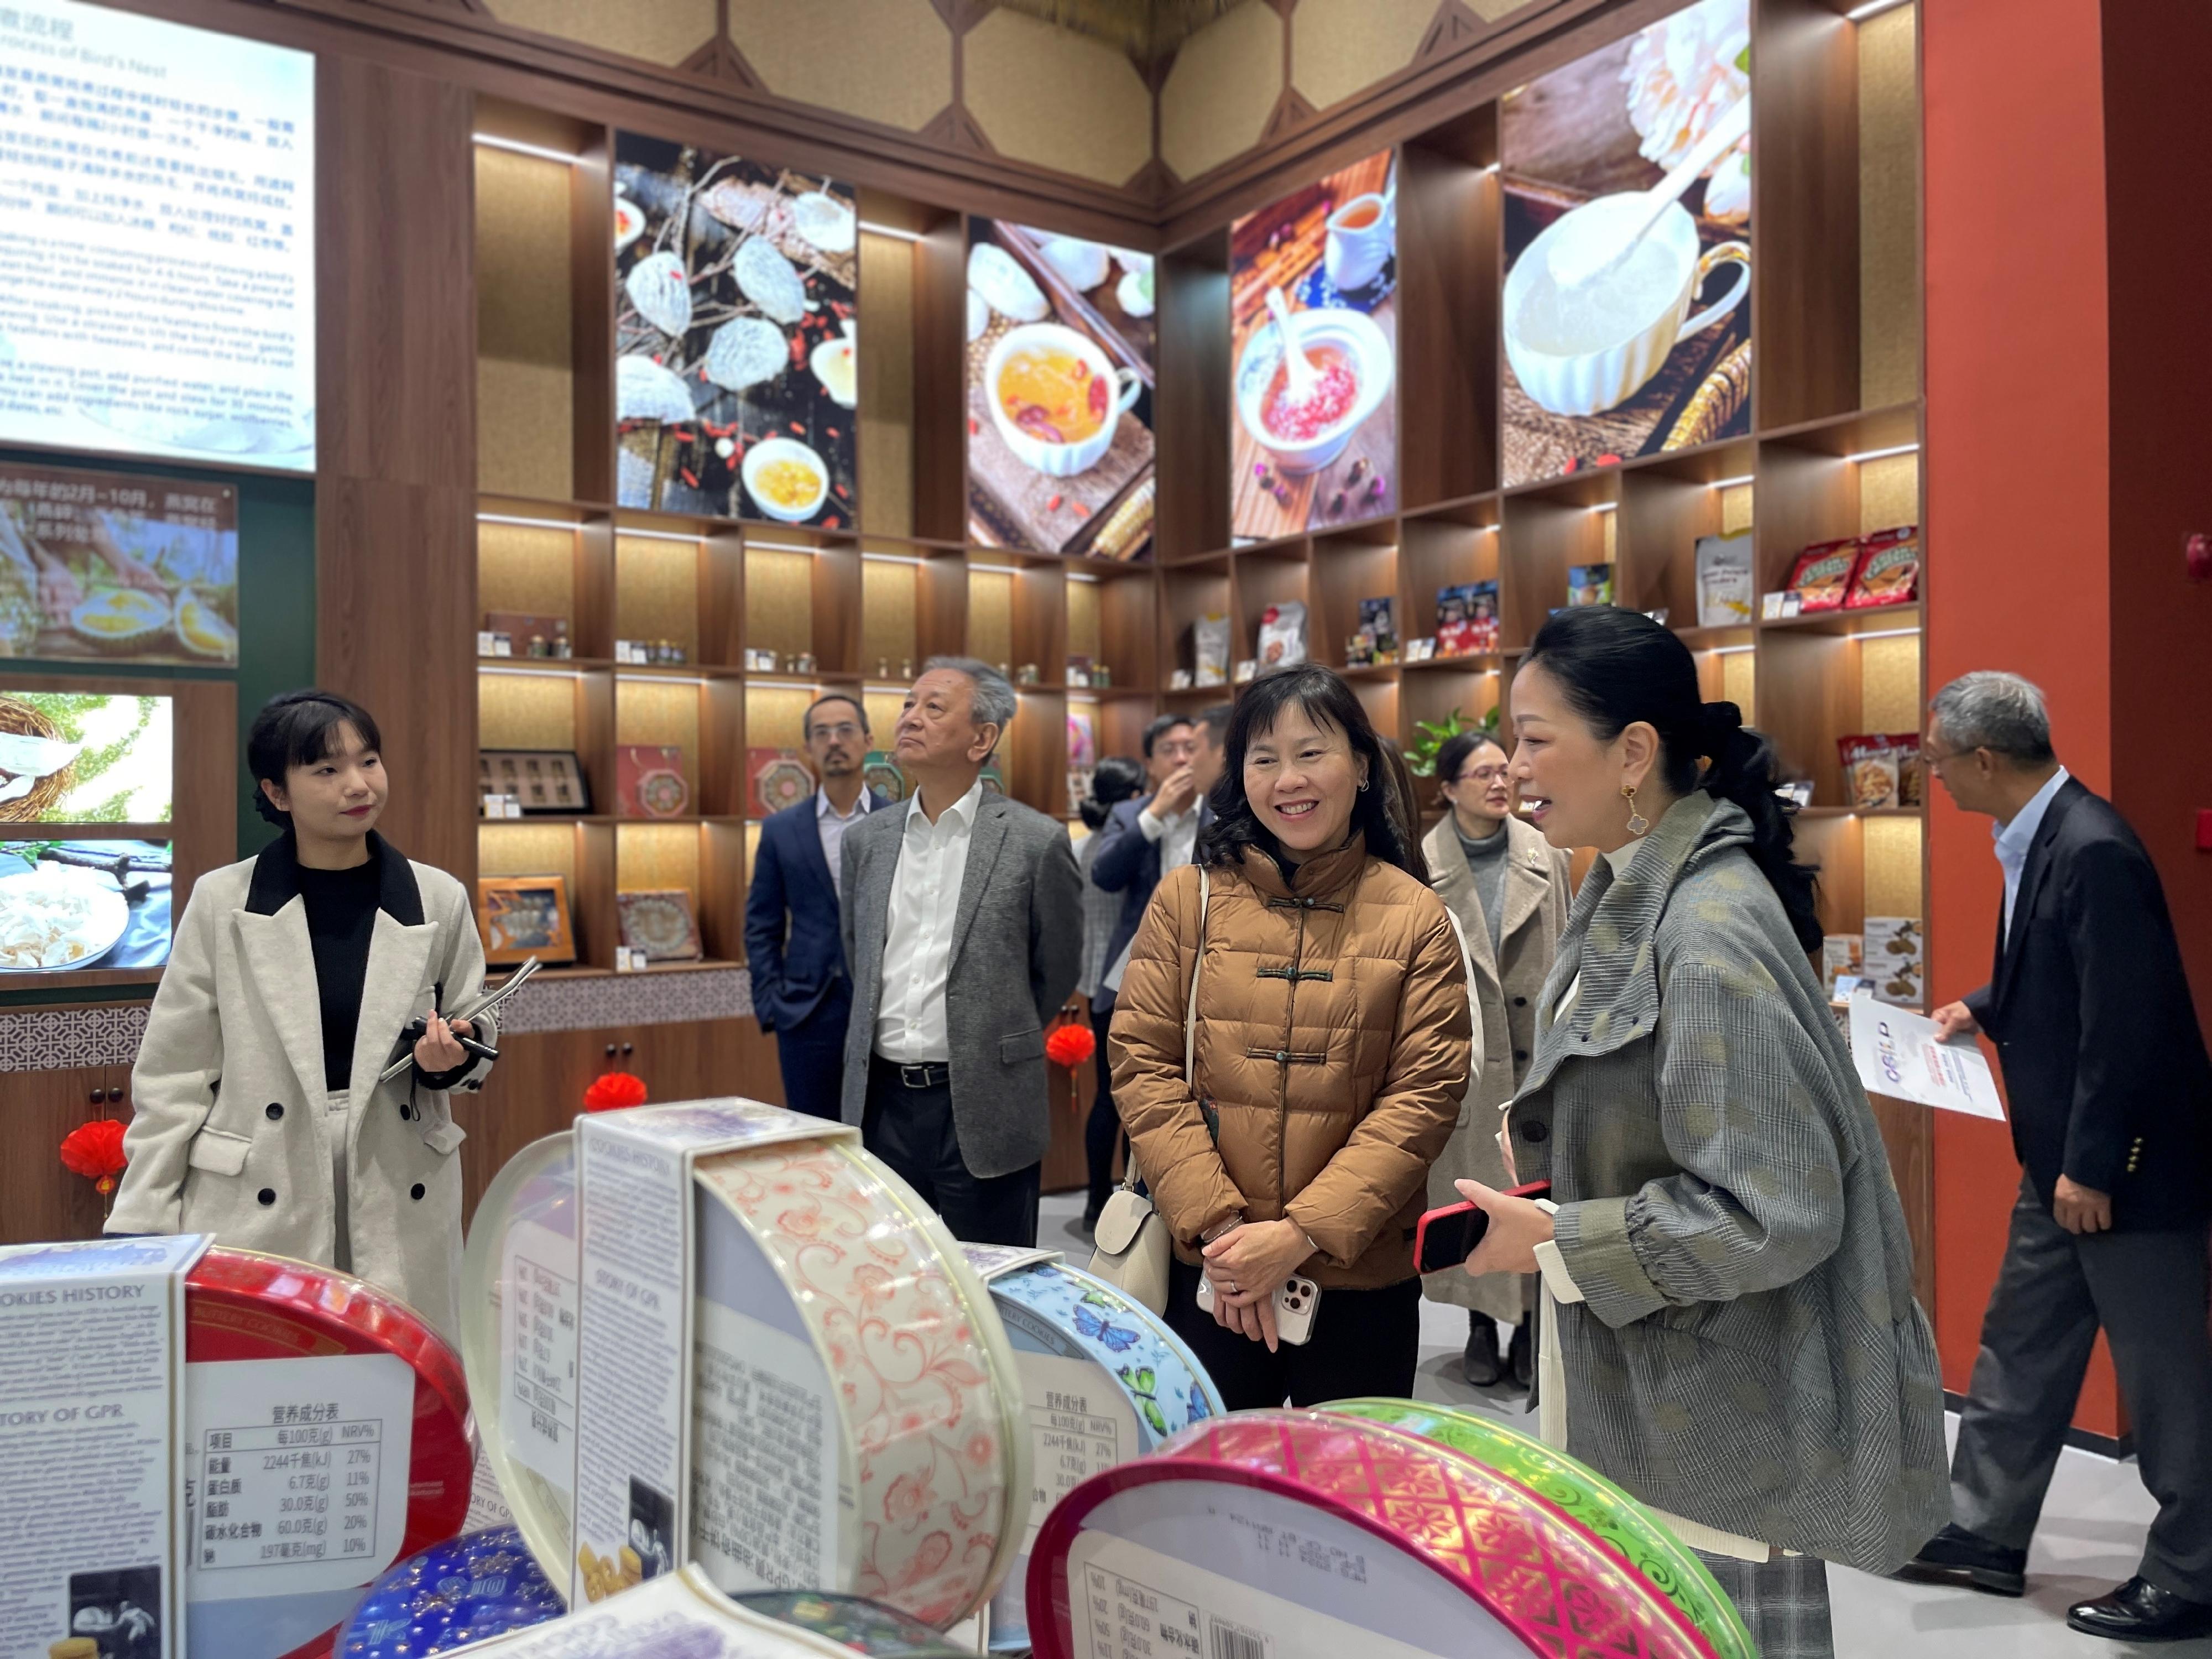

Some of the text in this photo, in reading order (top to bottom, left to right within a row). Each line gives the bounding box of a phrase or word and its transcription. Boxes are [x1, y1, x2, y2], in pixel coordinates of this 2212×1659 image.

[0, 230, 36, 247] oaking
[0, 1284, 145, 1307] OKIES HISTORY
[0, 1404, 124, 1427] TORY OF GPR
[272, 1402, 339, 1424] 营养成分表
[209, 1432, 232, 1449] 项目
[277, 1425, 333, 1446] 每100克(g)
[342, 1424, 374, 1439] NRV%
[208, 1457, 231, 1474] 能量
[347, 1449, 371, 1465] 27%
[207, 1478, 242, 1496] 蛋白质
[289, 1473, 331, 1491] 6.7克(g)
[346, 1471, 369, 1486] 11%
[206, 1492, 368, 1518] 脂肪 30.0克(g) 50%
[487, 1500, 498, 1513] OF
[278, 1517, 327, 1536] 60.0克(g)
[344, 1516, 367, 1530] 20%
[343, 1537, 366, 1553] 10%
